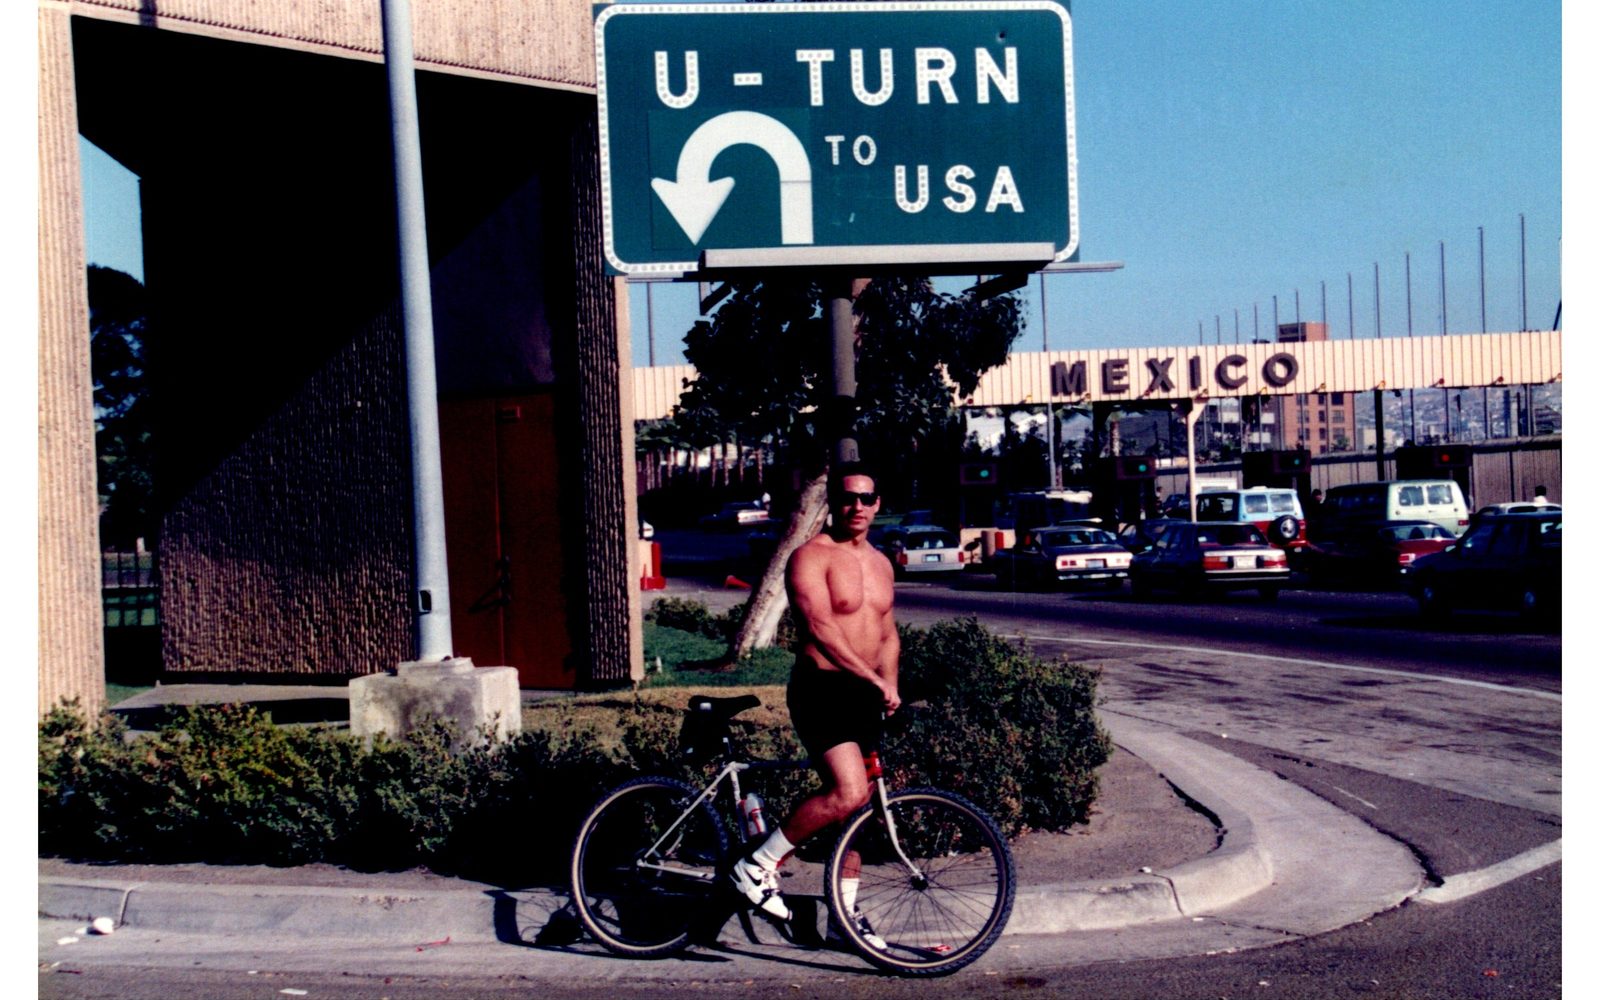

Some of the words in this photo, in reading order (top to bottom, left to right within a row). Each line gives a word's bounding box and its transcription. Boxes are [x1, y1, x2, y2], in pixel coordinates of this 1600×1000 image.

[824, 135, 877, 165] TO
[894, 164, 1025, 214] USA
[1050, 353, 1299, 396] MEXICO
